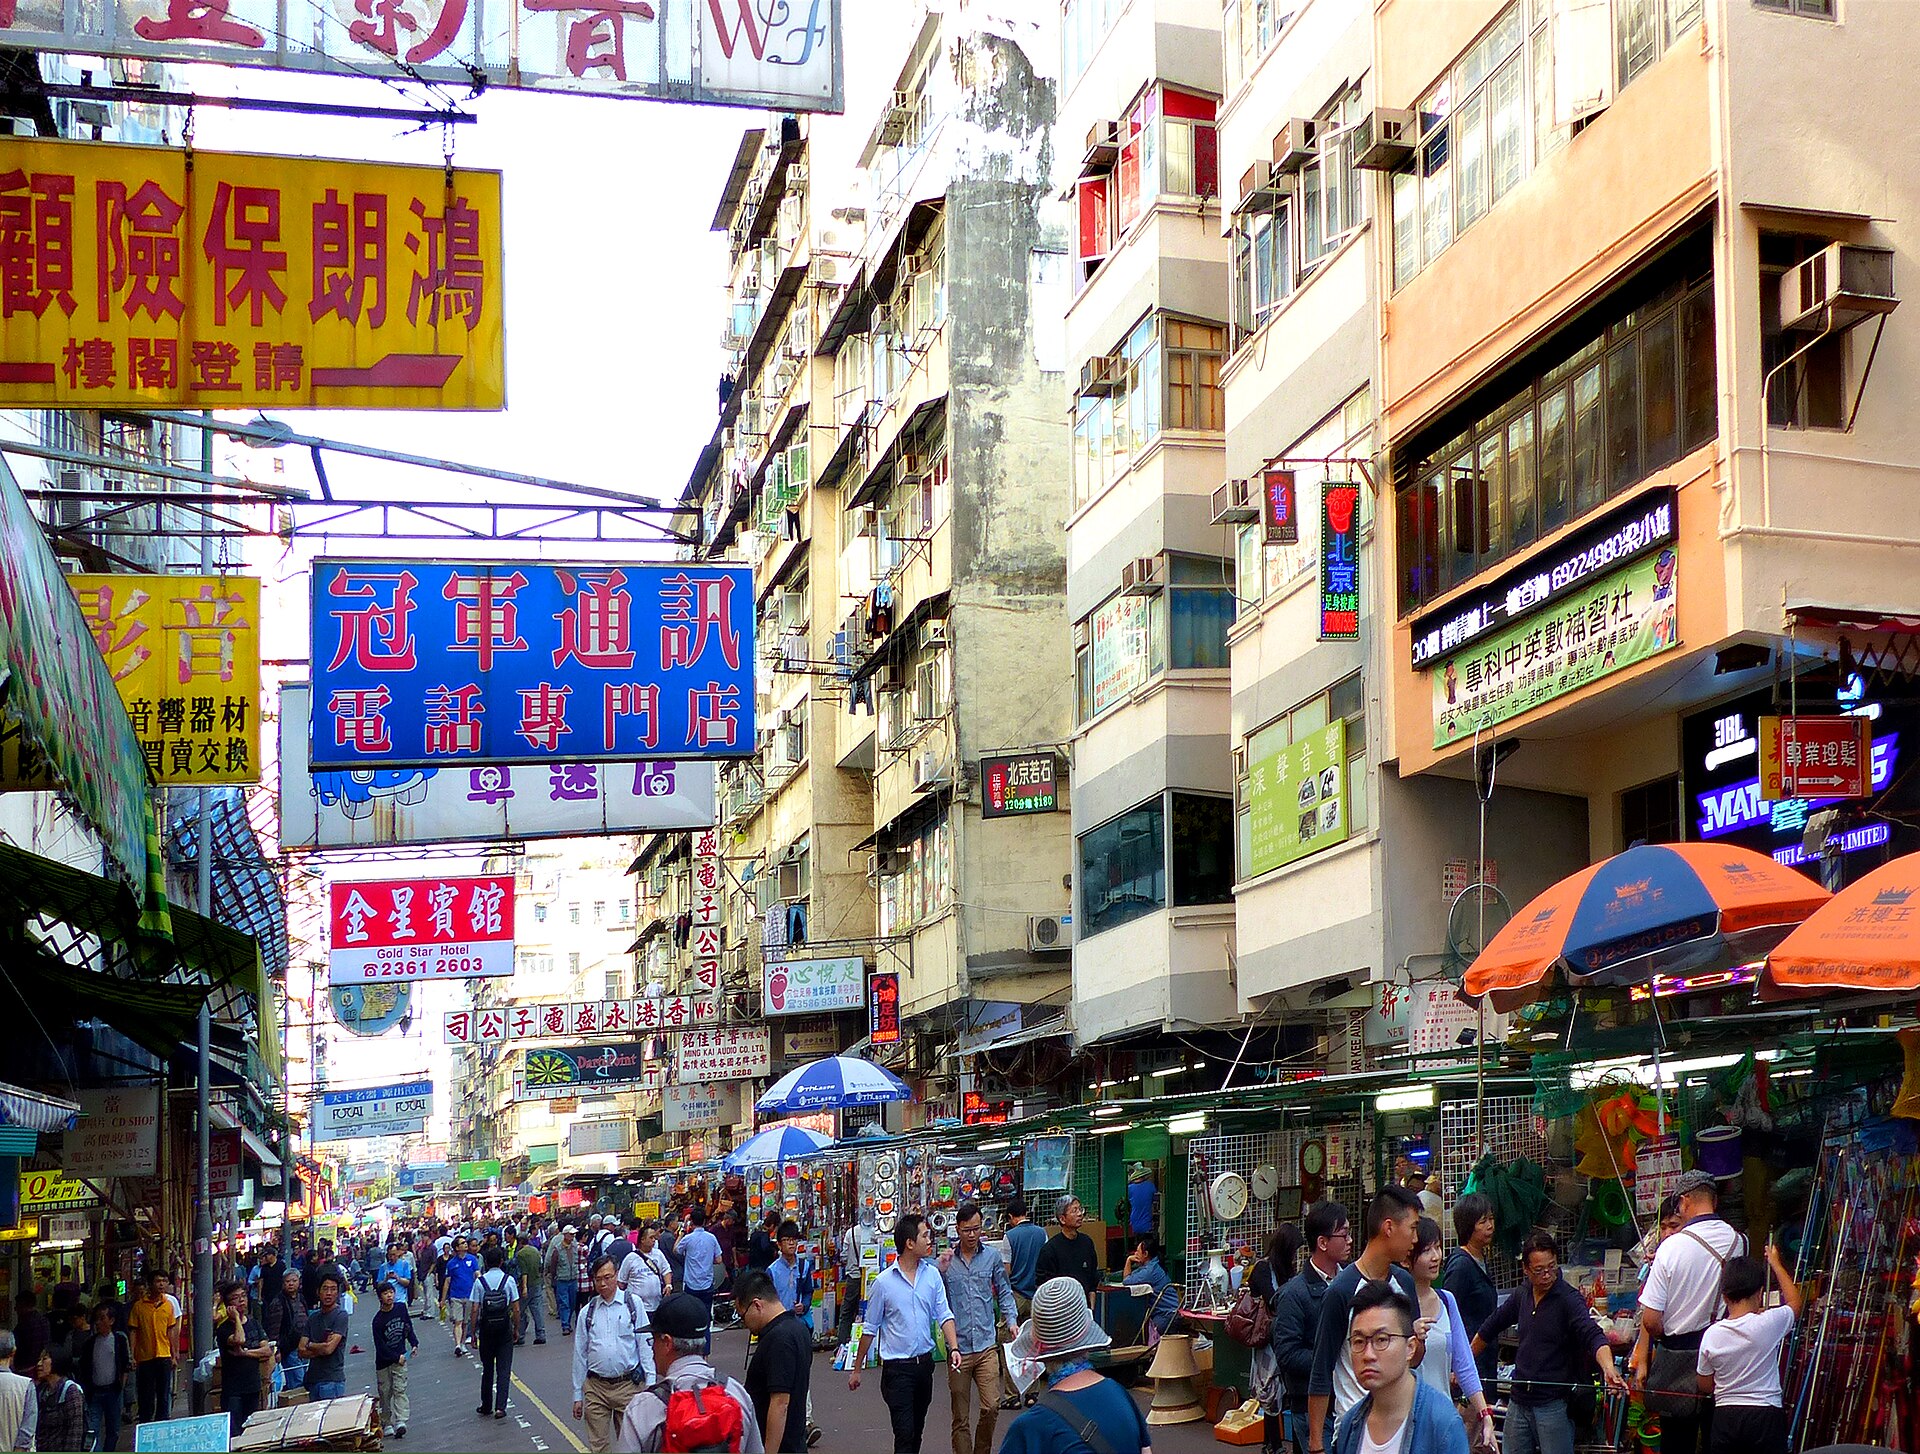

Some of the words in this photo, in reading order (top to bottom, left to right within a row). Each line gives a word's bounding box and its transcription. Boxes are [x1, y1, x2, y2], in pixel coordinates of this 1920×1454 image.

[1327, 533, 1355, 593] 北京
[327, 567, 743, 673] 冠軍通訊
[1465, 583, 1634, 693] 專科中英數補習社
[327, 682, 743, 756] 電話專門店
[1714, 713, 1746, 748] JBL
[1786, 740, 1856, 768] 專業理髮
[339, 882, 506, 942] 金星賓館
[1843, 906, 1916, 924] 洗樓王
[377, 946, 403, 959] Gold
[409, 946, 434, 957] Star
[440, 944, 469, 956] Hotel
[381, 960, 428, 976] 2361
[435, 957, 483, 973] 2603
[797, 998, 820, 1009] 3586
[703, 1048, 715, 1056] KAI
[717, 1046, 738, 1056] AUDIO
[707, 1071, 729, 1080] 2725
[128, 1115, 155, 1127] SHOP
